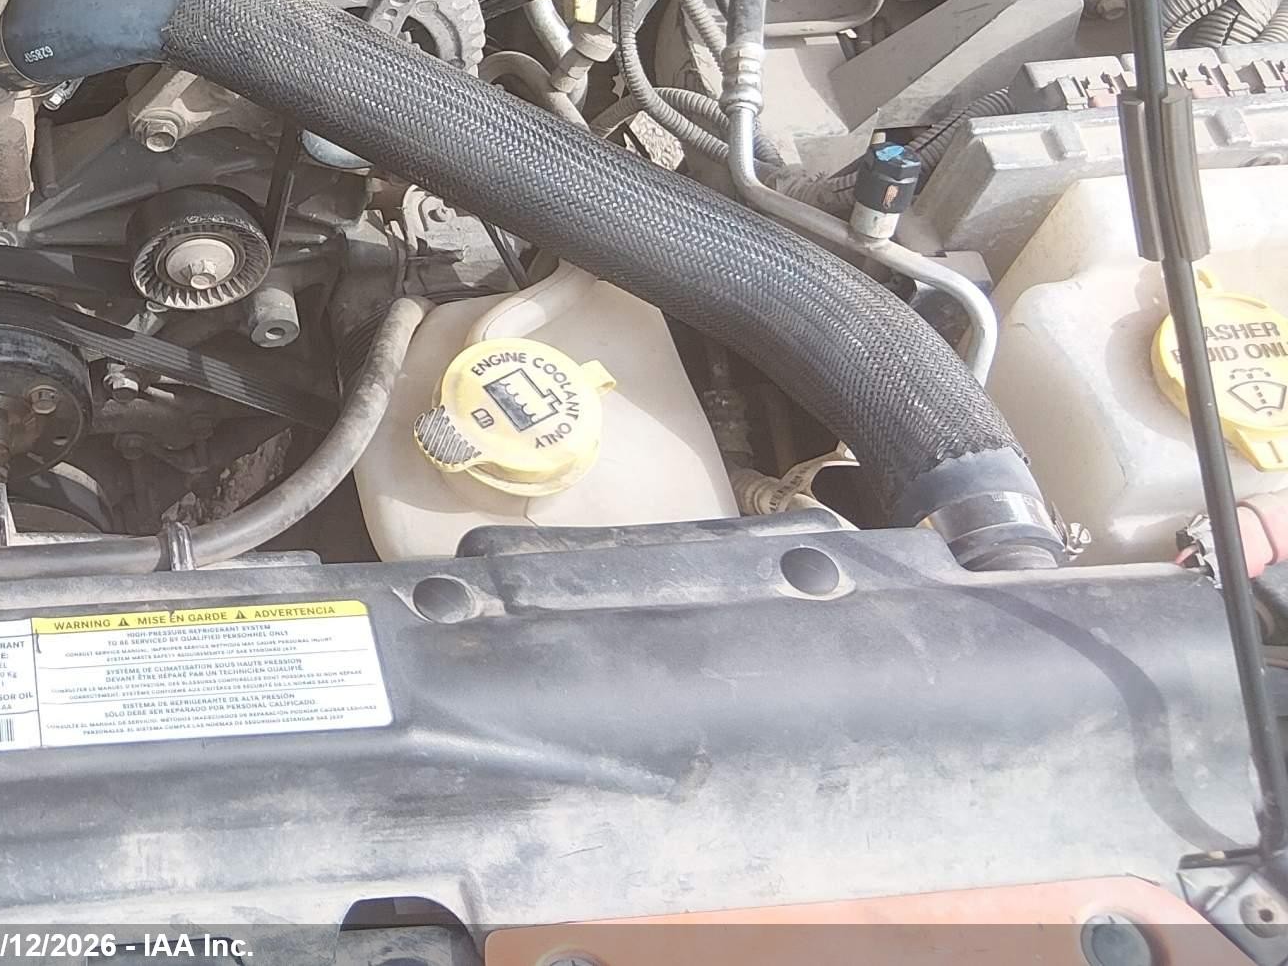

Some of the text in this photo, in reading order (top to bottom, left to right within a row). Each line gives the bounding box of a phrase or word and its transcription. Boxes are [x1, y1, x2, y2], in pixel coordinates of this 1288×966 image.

[1204, 321, 1281, 341] ASHER
[1244, 340, 1288, 360] ONL
[471, 352, 580, 449] ENGINE COOLANT ONLY
[54, 606, 336, 631] WARNING MISE EN GARDE ADVERTENCIA
[222, 631, 267, 639] PERSONNEL
[154, 663, 213, 672] CLIMATISATION
[219, 668, 265, 676] TECHNICIEN
[18, 692, 34, 700] OIL
[170, 697, 227, 706] REFRIGERANTE
[226, 702, 267, 710] PERSONAL
